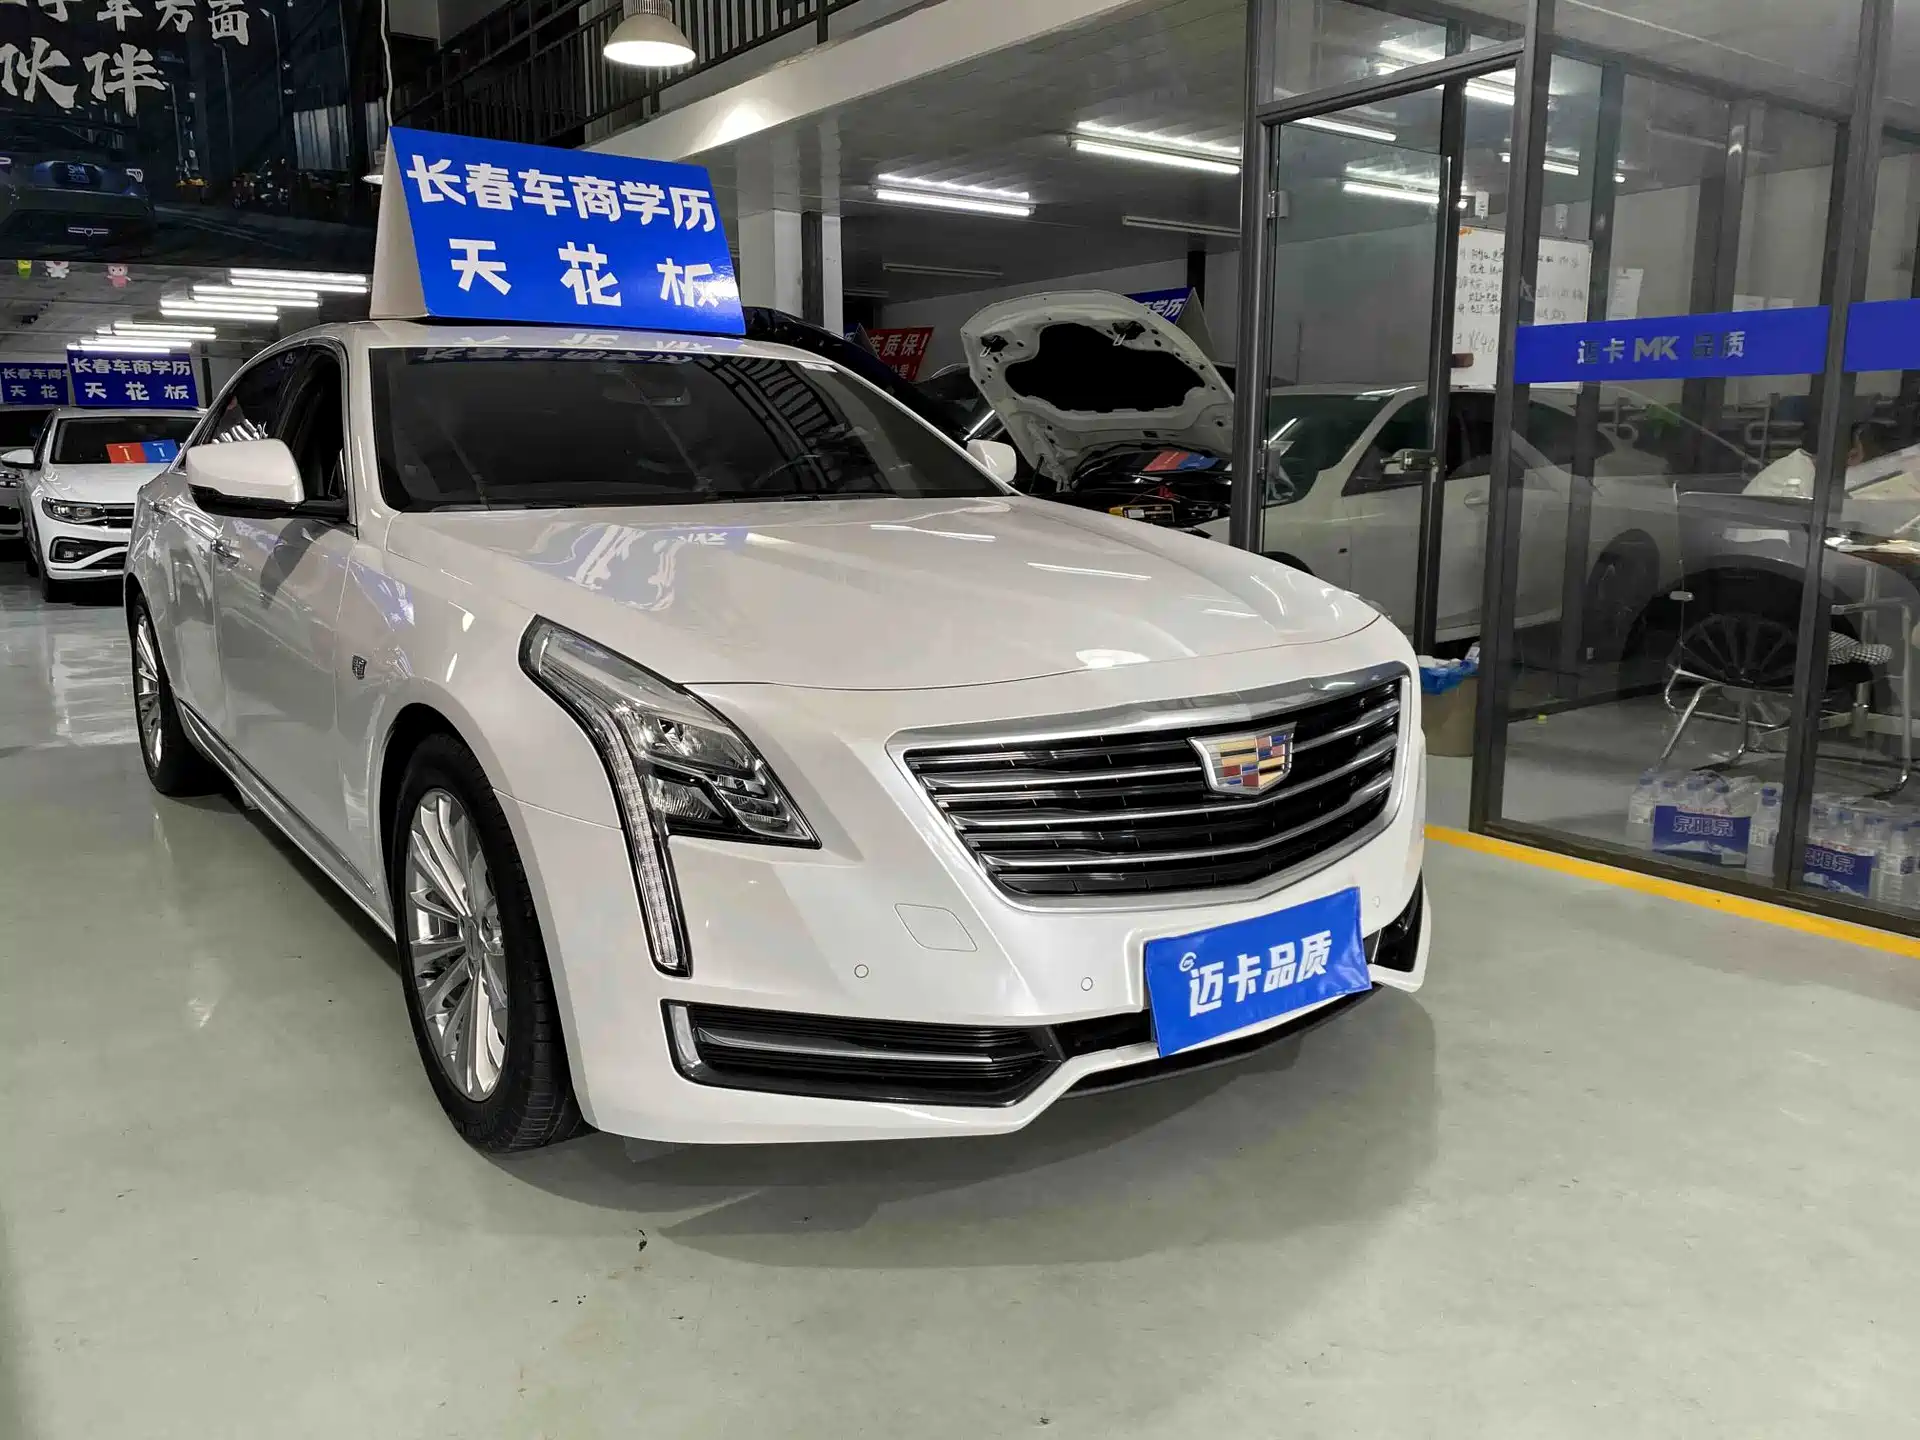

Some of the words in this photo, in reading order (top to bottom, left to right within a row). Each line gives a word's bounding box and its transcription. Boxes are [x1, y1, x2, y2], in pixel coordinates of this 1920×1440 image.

[0, 0, 250, 46] 车方面
[0, 37, 167, 117] 伙伴
[407, 154, 716, 232] 长春车商学历
[448, 237, 721, 308] 天花板
[71, 357, 191, 376] 长春车商学历
[1577, 338, 1625, 365] 迈卡
[1633, 335, 1680, 363] MK
[1692, 331, 1746, 359] 品质
[10, 383, 59, 399] 天花
[84, 380, 190, 401] 天花板
[1189, 929, 1333, 1018] 迈卡品质
